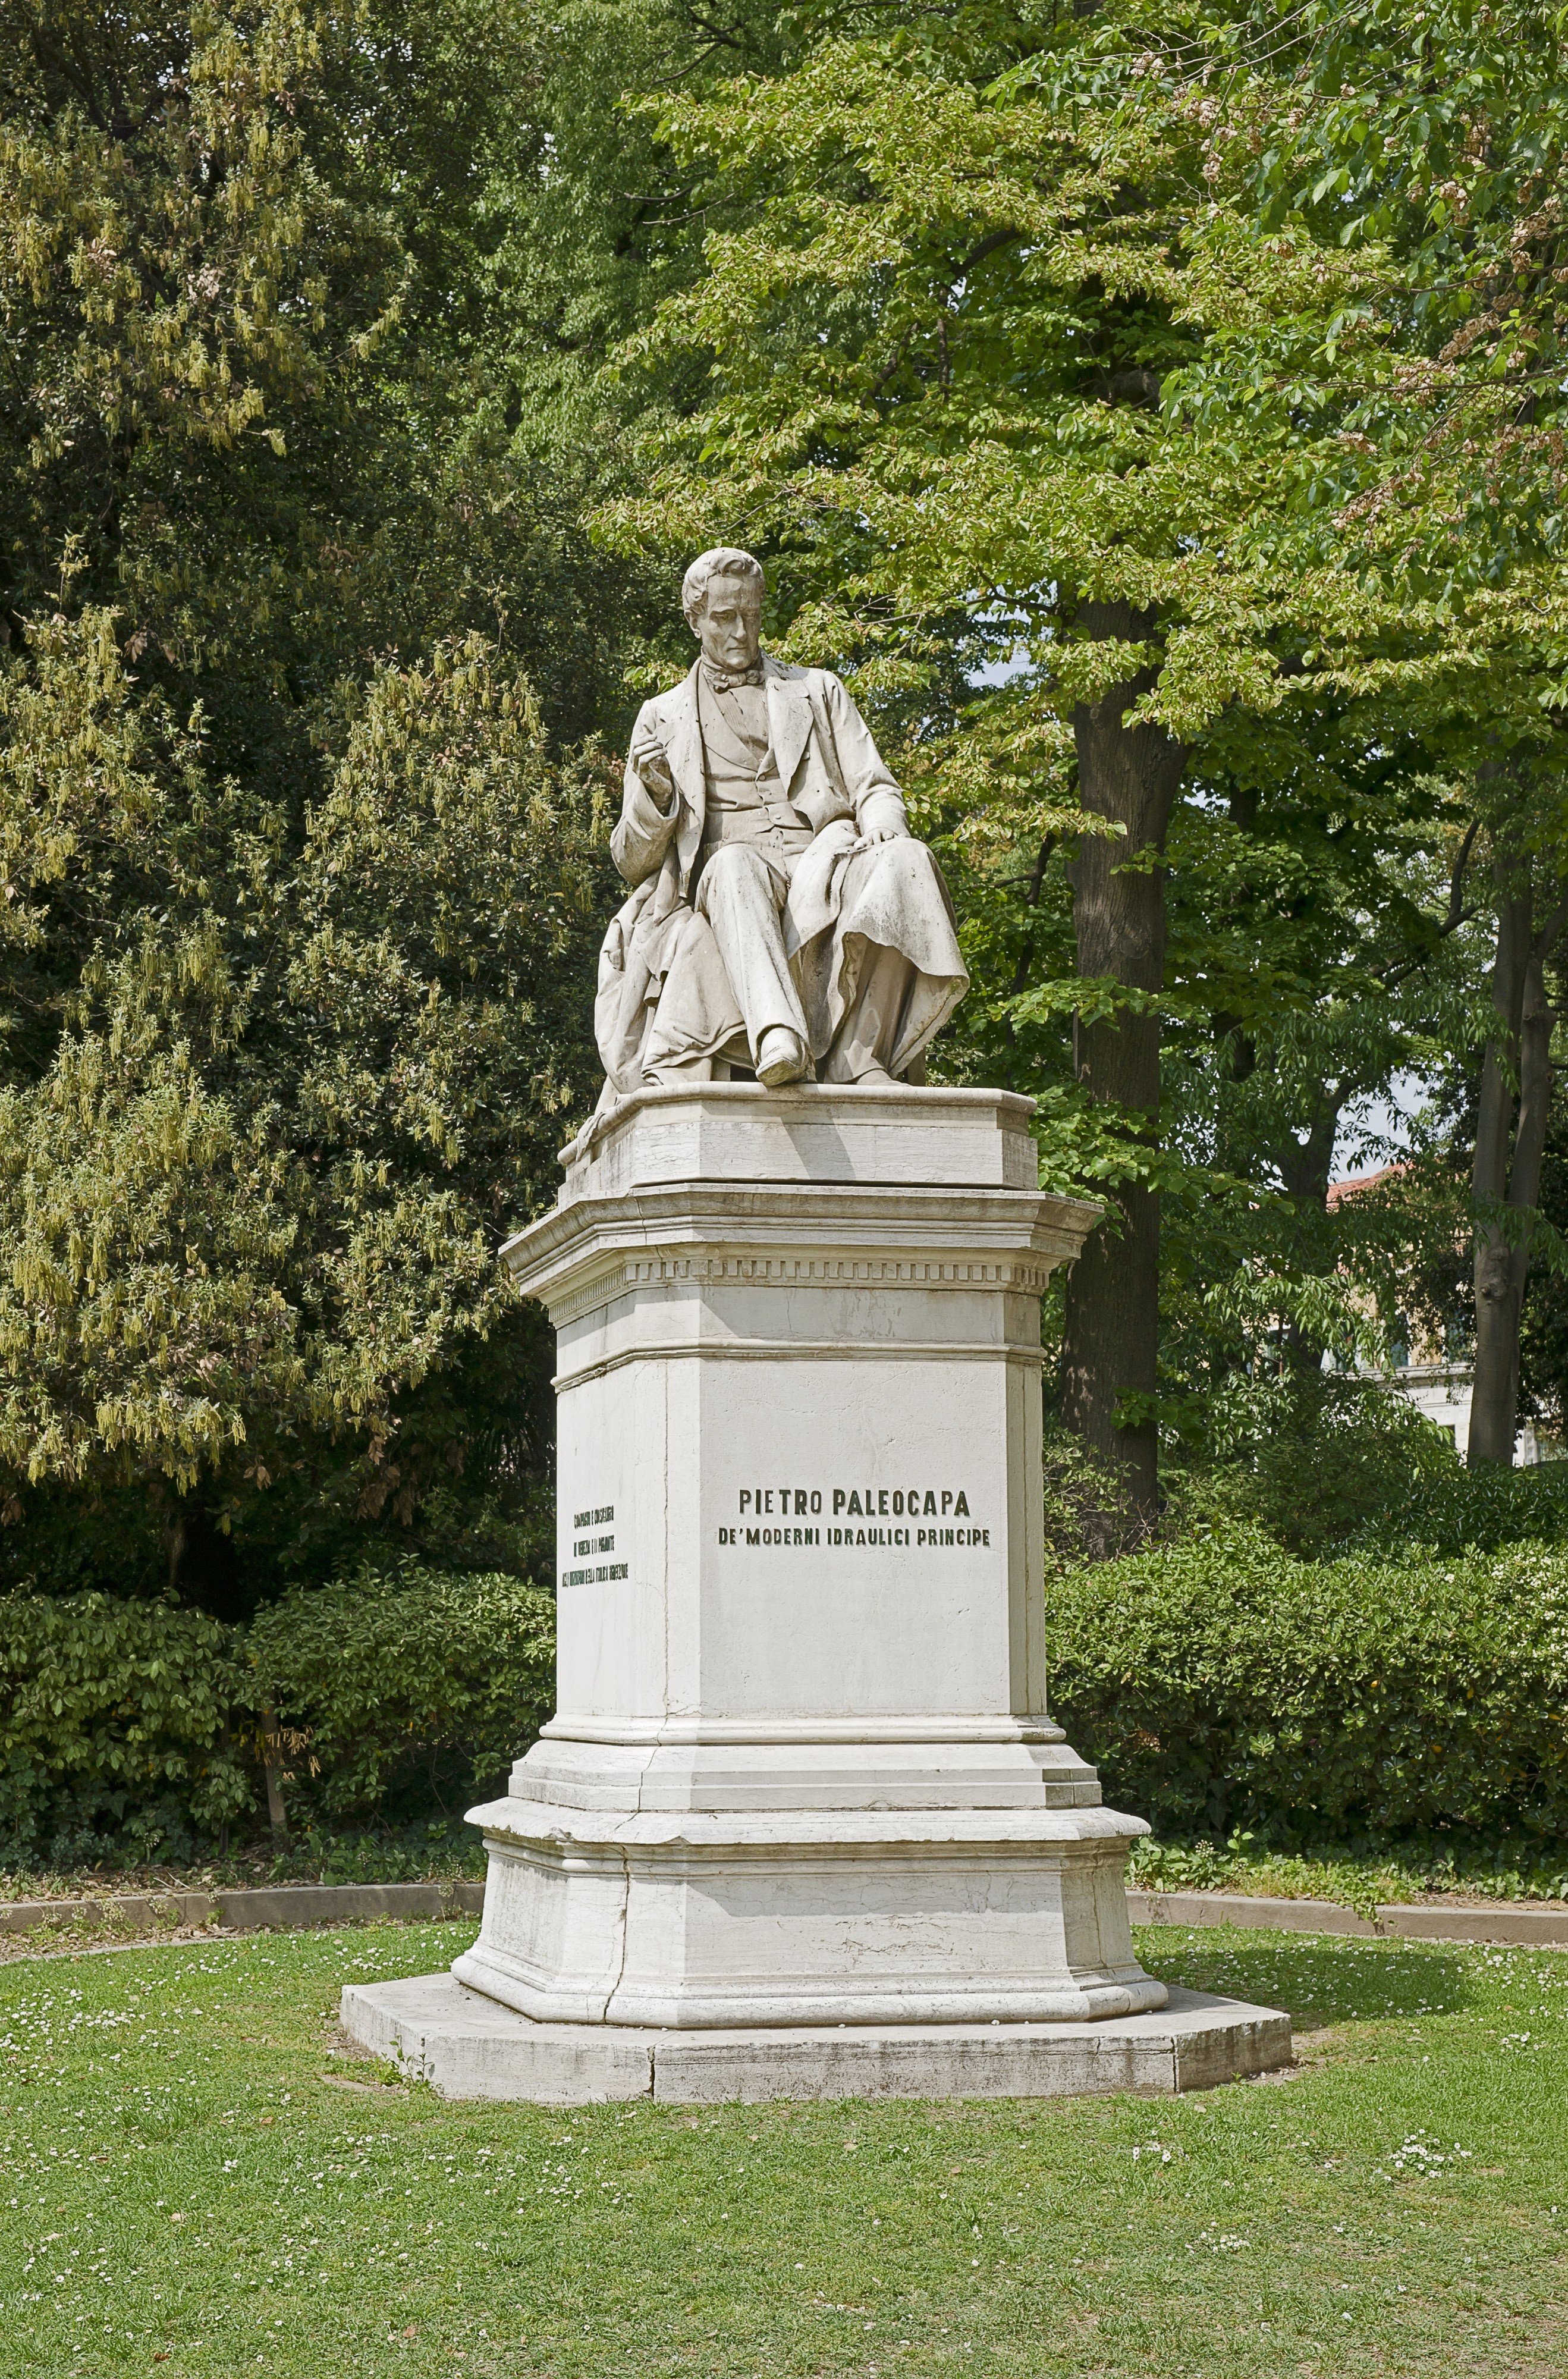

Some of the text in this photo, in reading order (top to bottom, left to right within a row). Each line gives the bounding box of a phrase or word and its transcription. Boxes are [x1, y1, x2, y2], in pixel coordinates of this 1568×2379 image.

[739, 1489, 970, 1516] PIETRO PALEOCAPA
[592, 1510, 593, 1526] E
[827, 1528, 909, 1546] IDRAULICI
[917, 1529, 991, 1546] PRINCIPE
[592, 1539, 593, 1555] E
